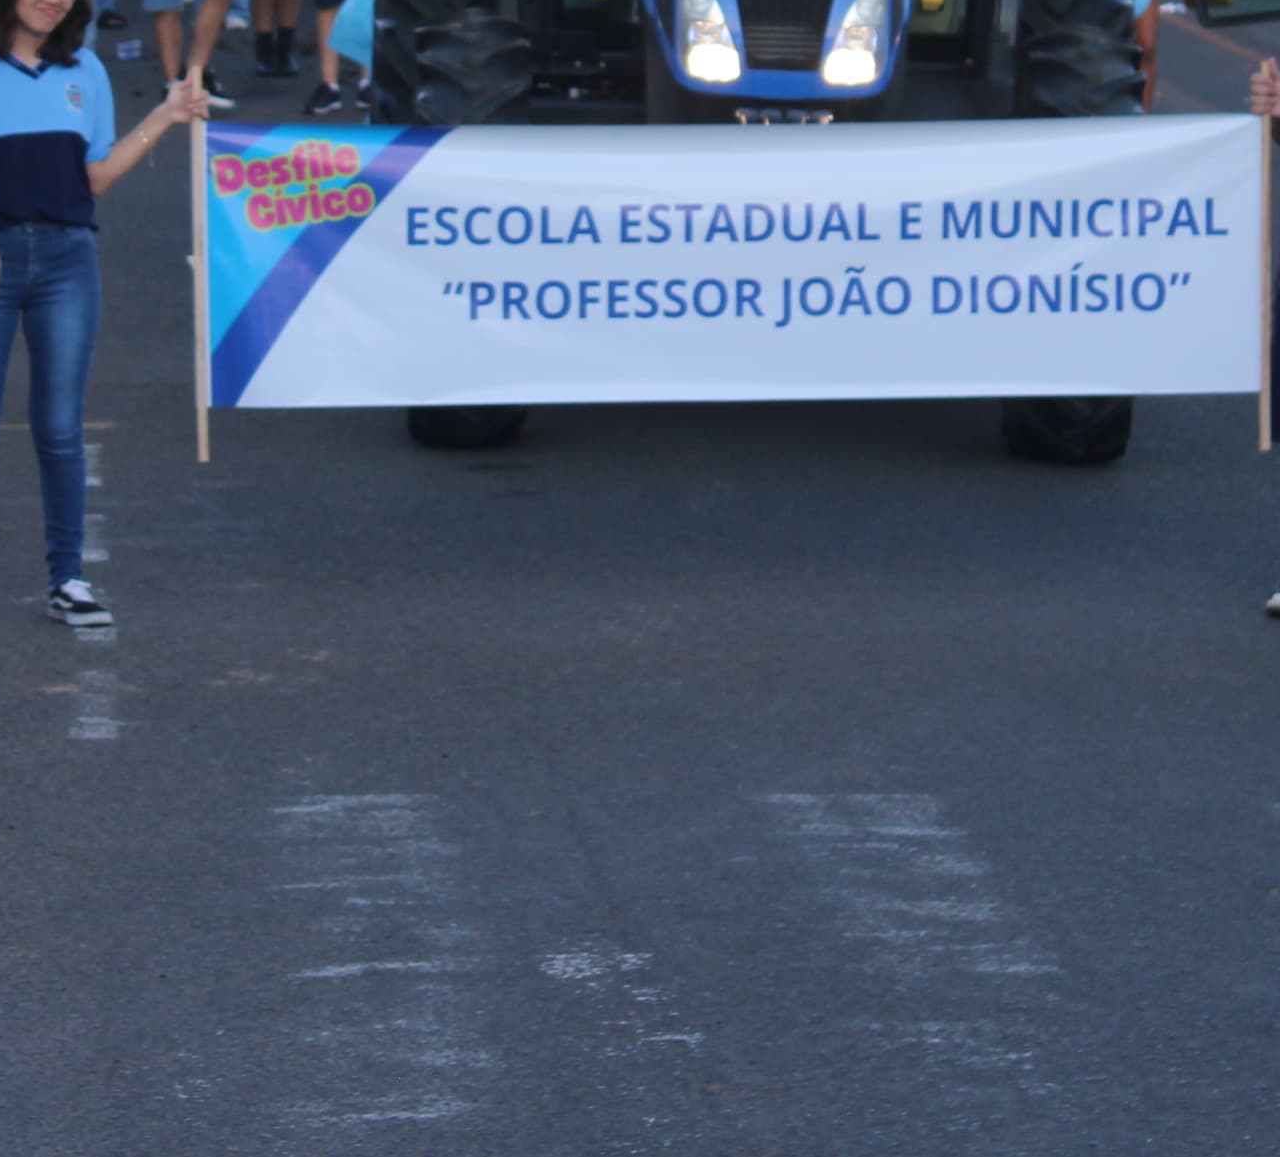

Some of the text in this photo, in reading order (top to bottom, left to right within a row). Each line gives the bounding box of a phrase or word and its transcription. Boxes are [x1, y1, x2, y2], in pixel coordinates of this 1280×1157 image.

[212, 139, 360, 195] Desfile
[405, 197, 1231, 249] ESCOLA ESTADUAL E MUNICIPAL
[770, 266, 913, 330] JOÃO
